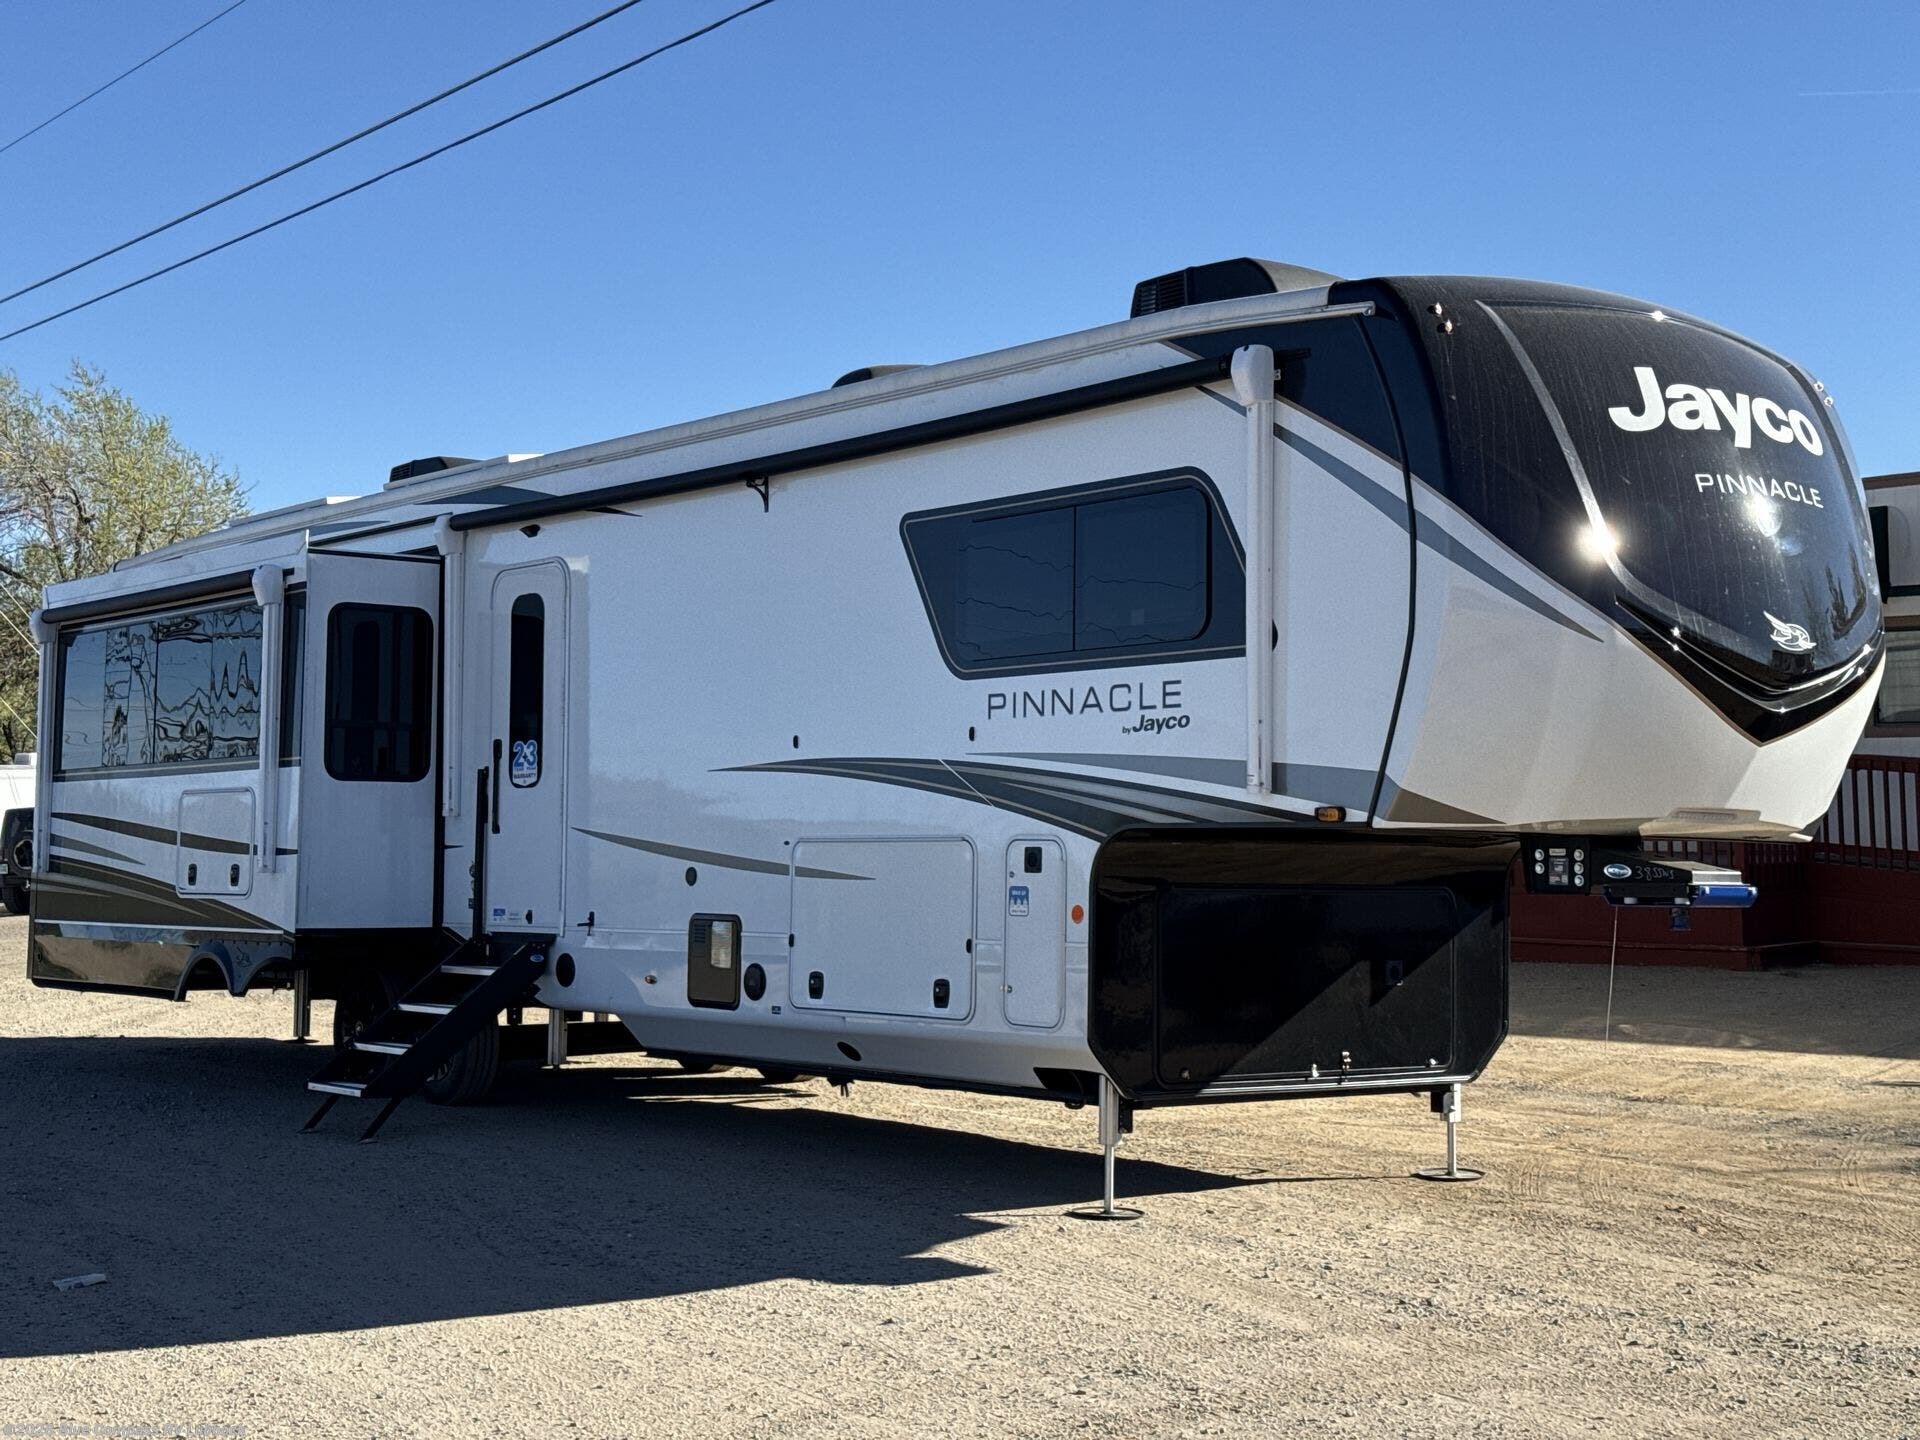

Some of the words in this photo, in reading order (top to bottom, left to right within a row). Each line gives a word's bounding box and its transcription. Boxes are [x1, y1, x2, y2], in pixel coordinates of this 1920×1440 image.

[1608, 366, 1824, 456] Jayco
[1695, 473, 1824, 508] PINNACLE
[987, 679, 1182, 720] PINNACLE
[1122, 726, 1132, 734] by
[1133, 714, 1190, 734] Jayco
